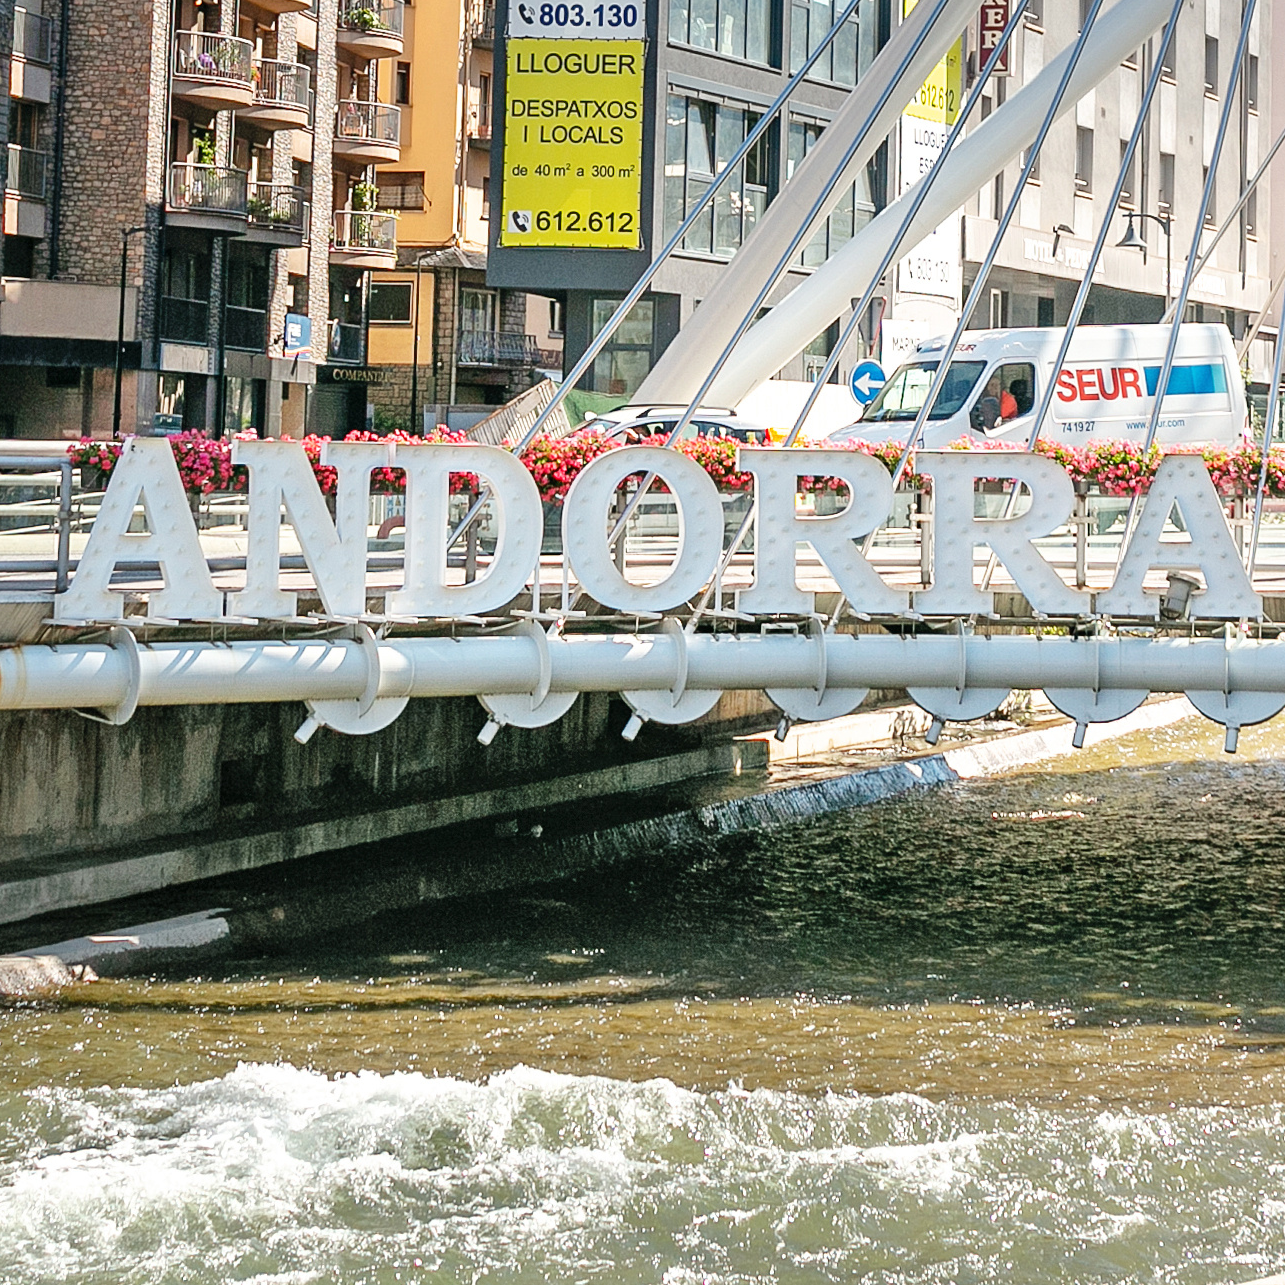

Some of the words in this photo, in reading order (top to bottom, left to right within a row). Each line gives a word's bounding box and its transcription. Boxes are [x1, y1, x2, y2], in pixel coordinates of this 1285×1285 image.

[539, 3, 638, 27] 803.130
[517, 53, 636, 74] LLOGUER
[511, 99, 638, 119] DESPATXOS
[523, 125, 528, 143] I
[540, 125, 624, 144] LOCALS
[512, 164, 528, 176] de
[534, 164, 551, 176] 40
[576, 167, 585, 177] a
[591, 165, 615, 178] 300
[536, 210, 634, 233] 612.612
[953, 343, 977, 352] EUR
[1056, 367, 1143, 403] SEUR
[1061, 422, 1072, 433] 74
[1074, 421, 1084, 432] 19
[1085, 421, 1095, 432] 27
[1126, 419, 1185, 430] www.ur.com
[55, 436, 1264, 620] ANDORRA
